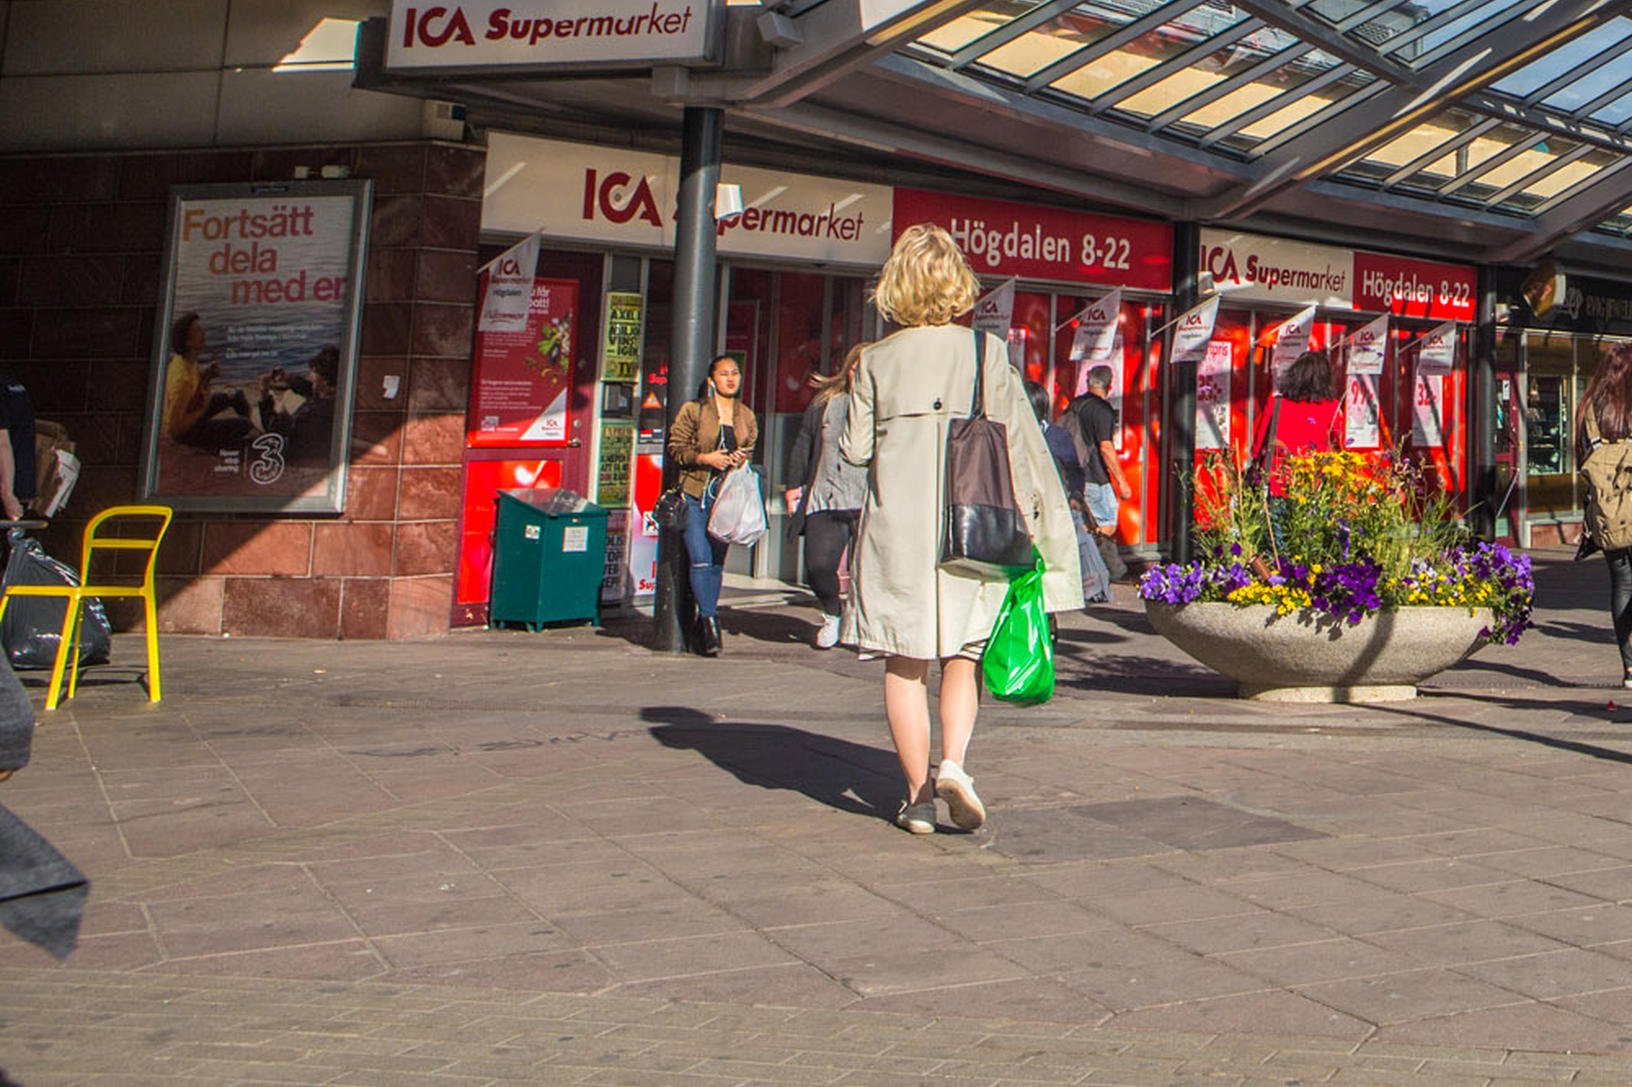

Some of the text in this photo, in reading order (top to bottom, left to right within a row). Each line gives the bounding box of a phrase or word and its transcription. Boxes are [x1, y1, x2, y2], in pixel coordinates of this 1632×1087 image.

[403, 1, 693, 48] ICA Supermarket
[182, 205, 314, 242] Fortsätt
[583, 168, 864, 241] ICA permarket
[208, 243, 278, 275] dela
[950, 218, 1131, 270] Högdalen 8-22
[231, 270, 346, 305] med er
[499, 258, 521, 275] ICA
[1200, 245, 1470, 307] ICA Supermarket Högdalen 8-22
[1087, 308, 1107, 321] ICA
[249, 432, 285, 485] 3
